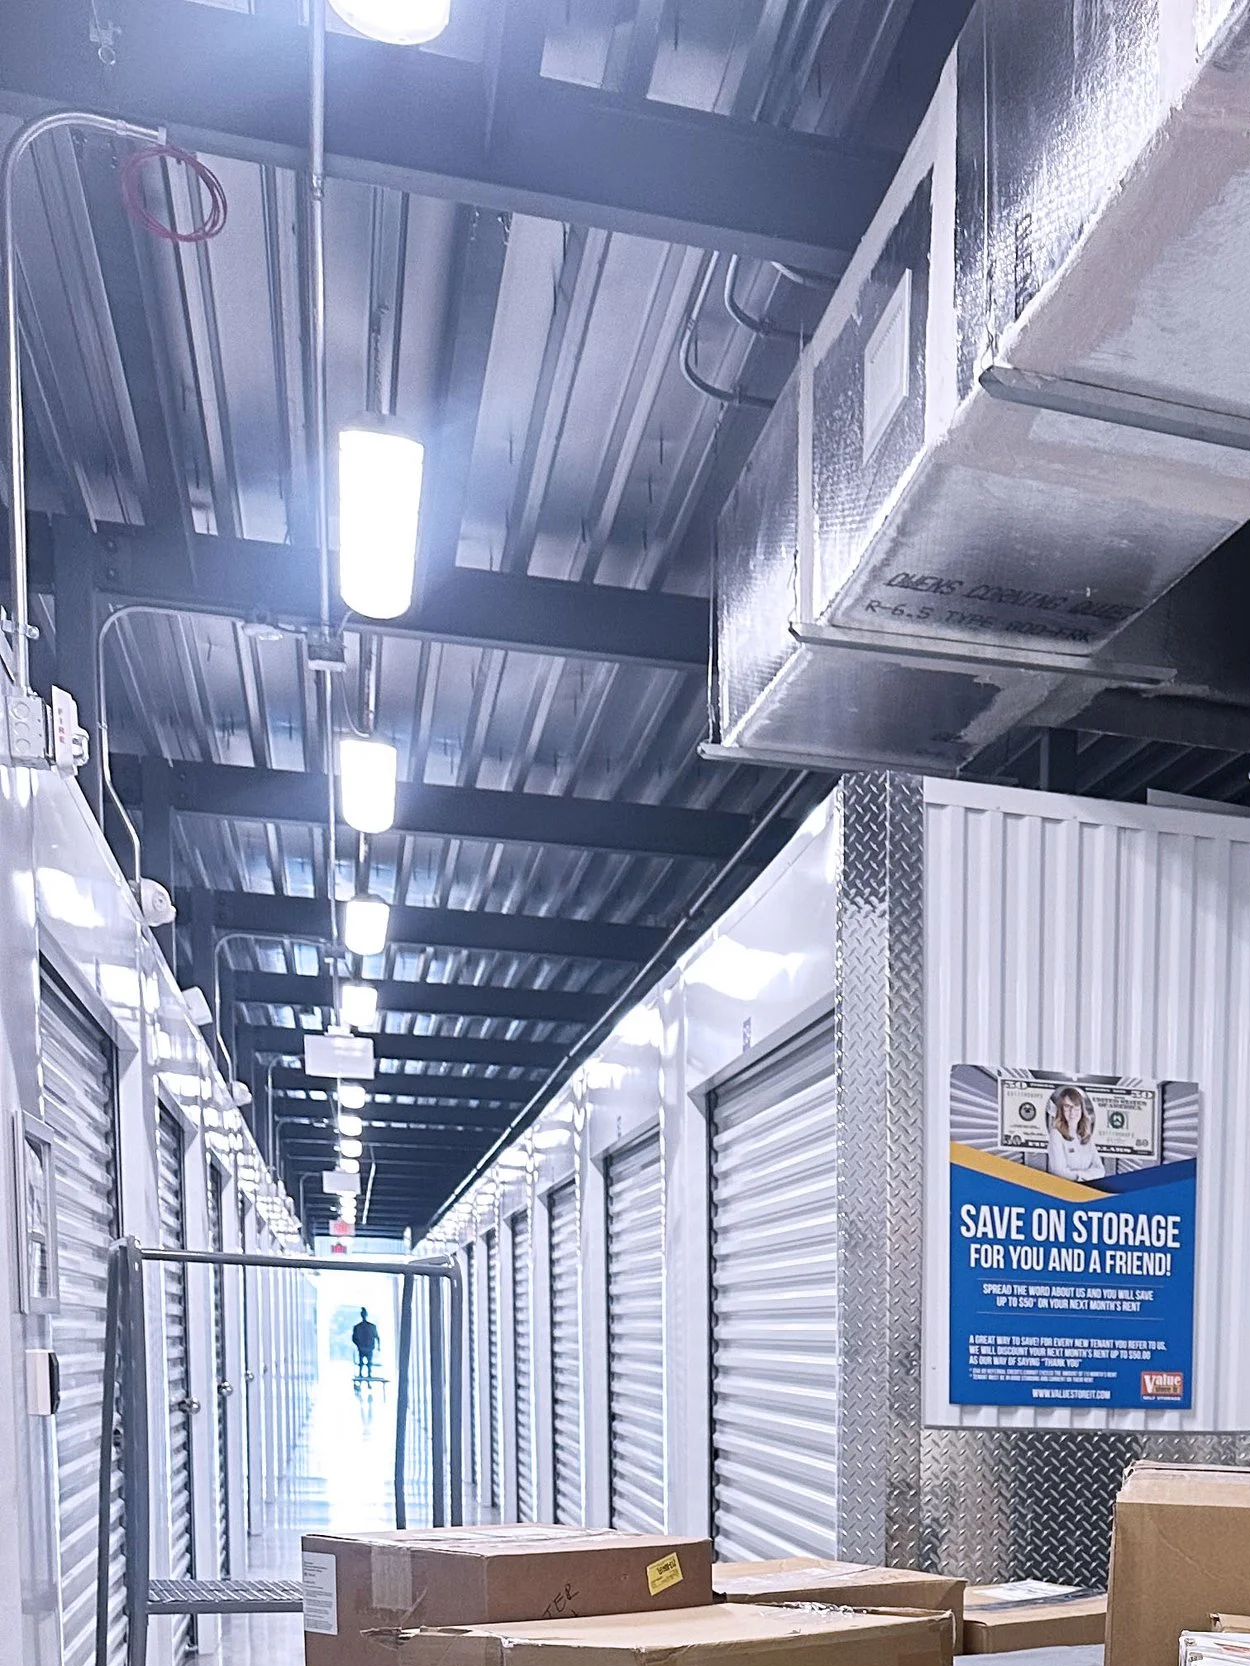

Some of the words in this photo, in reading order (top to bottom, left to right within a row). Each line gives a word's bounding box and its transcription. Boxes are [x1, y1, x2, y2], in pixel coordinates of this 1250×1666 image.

[883, 572, 964, 595] OWENS
[865, 600, 935, 619] R-6.5
[945, 610, 996, 629] TYPE
[960, 1204, 1025, 1240] SAVE
[1032, 1208, 1065, 1242] ON
[1072, 1210, 1181, 1248] STORAGE
[970, 1244, 1004, 1269] FOR
[1009, 1246, 1044, 1271] YOU
[1048, 1248, 1085, 1273] AND
[1089, 1250, 1101, 1273] A
[1105, 1250, 1172, 1277] FRIEND!
[983, 1284, 1012, 1295] SPREAD
[1013, 1285, 1028, 1296] THE
[1028, 1285, 1051, 1297] WORD
[1051, 1286, 1075, 1298] ABOUT
[1076, 1287, 1086, 1298] US
[1087, 1288, 1101, 1299] AND
[1102, 1288, 1117, 1300] YOU
[1117, 1289, 1135, 1300] WILL
[1135, 1290, 1154, 1301] SAVE
[996, 1296, 1007, 1307] UP
[1008, 1297, 1019, 1308] TO
[1037, 1298, 1049, 1309] ON
[1050, 1299, 1069, 1310] YOUR
[1069, 1299, 1089, 1311] NEXT
[1122, 1301, 1141, 1313] RENT
[969, 1335, 975, 1344] A
[1143, 1373, 1182, 1394] Value
